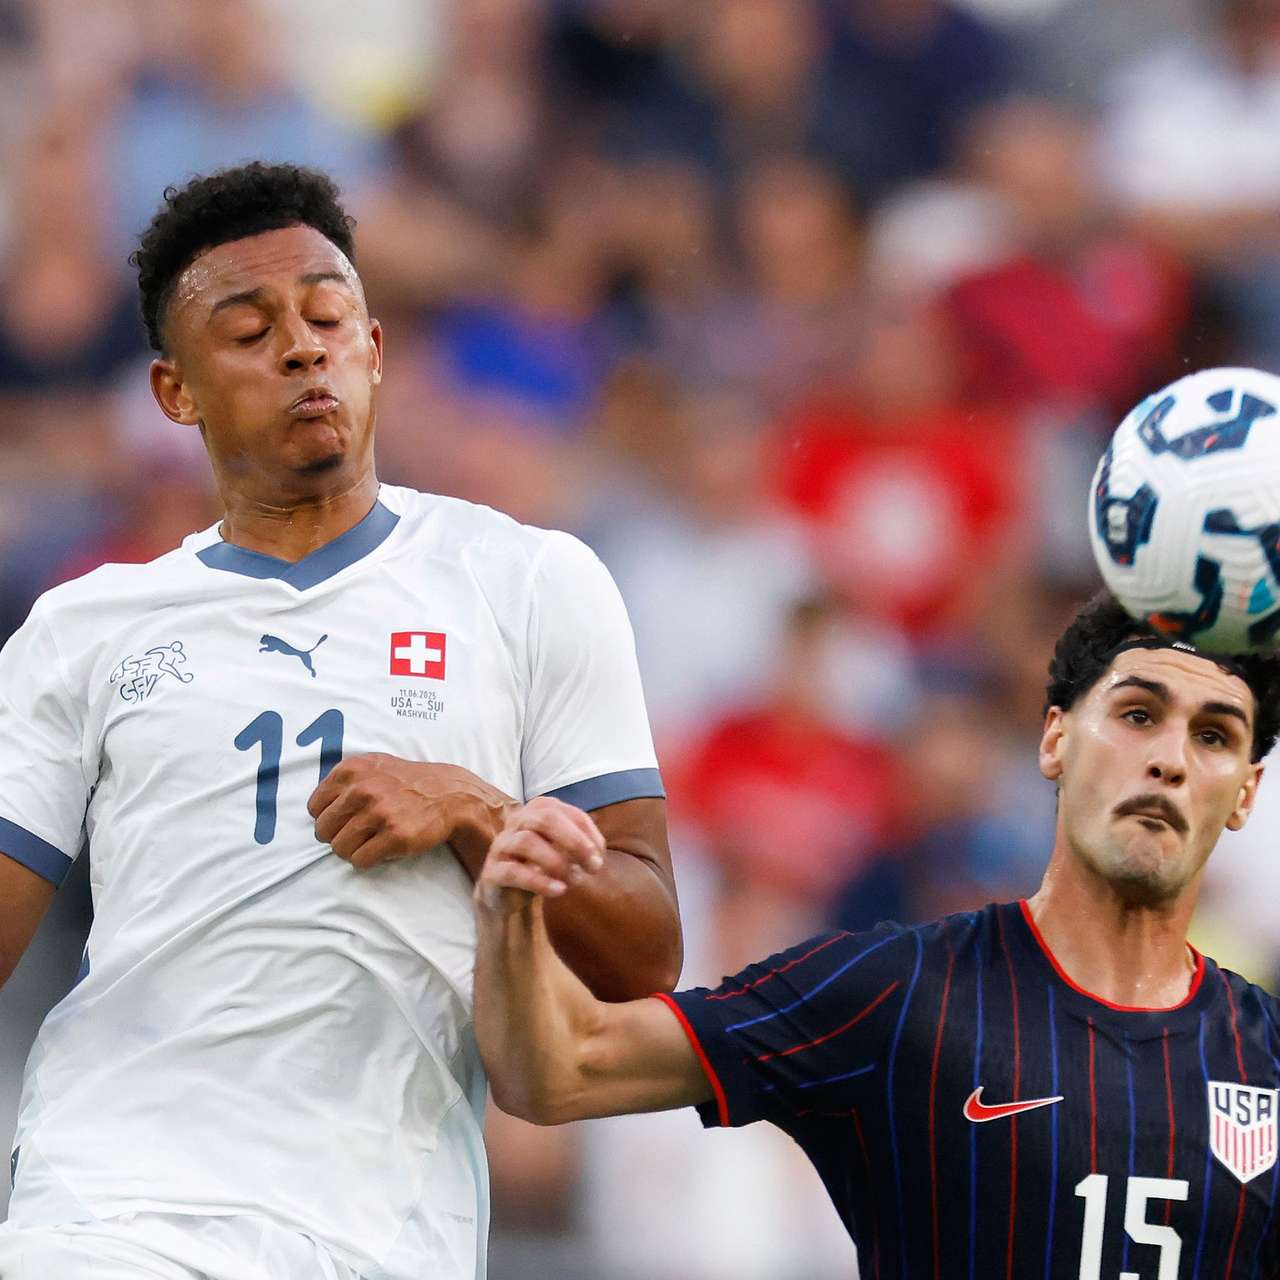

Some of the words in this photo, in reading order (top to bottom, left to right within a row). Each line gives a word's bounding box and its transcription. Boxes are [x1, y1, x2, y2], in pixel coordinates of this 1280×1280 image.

[391, 696, 413, 709] USA
[427, 700, 444, 713] SUI
[396, 708, 438, 721] NASHVILLE
[234, 708, 345, 845] 11
[1214, 1087, 1272, 1127] USA
